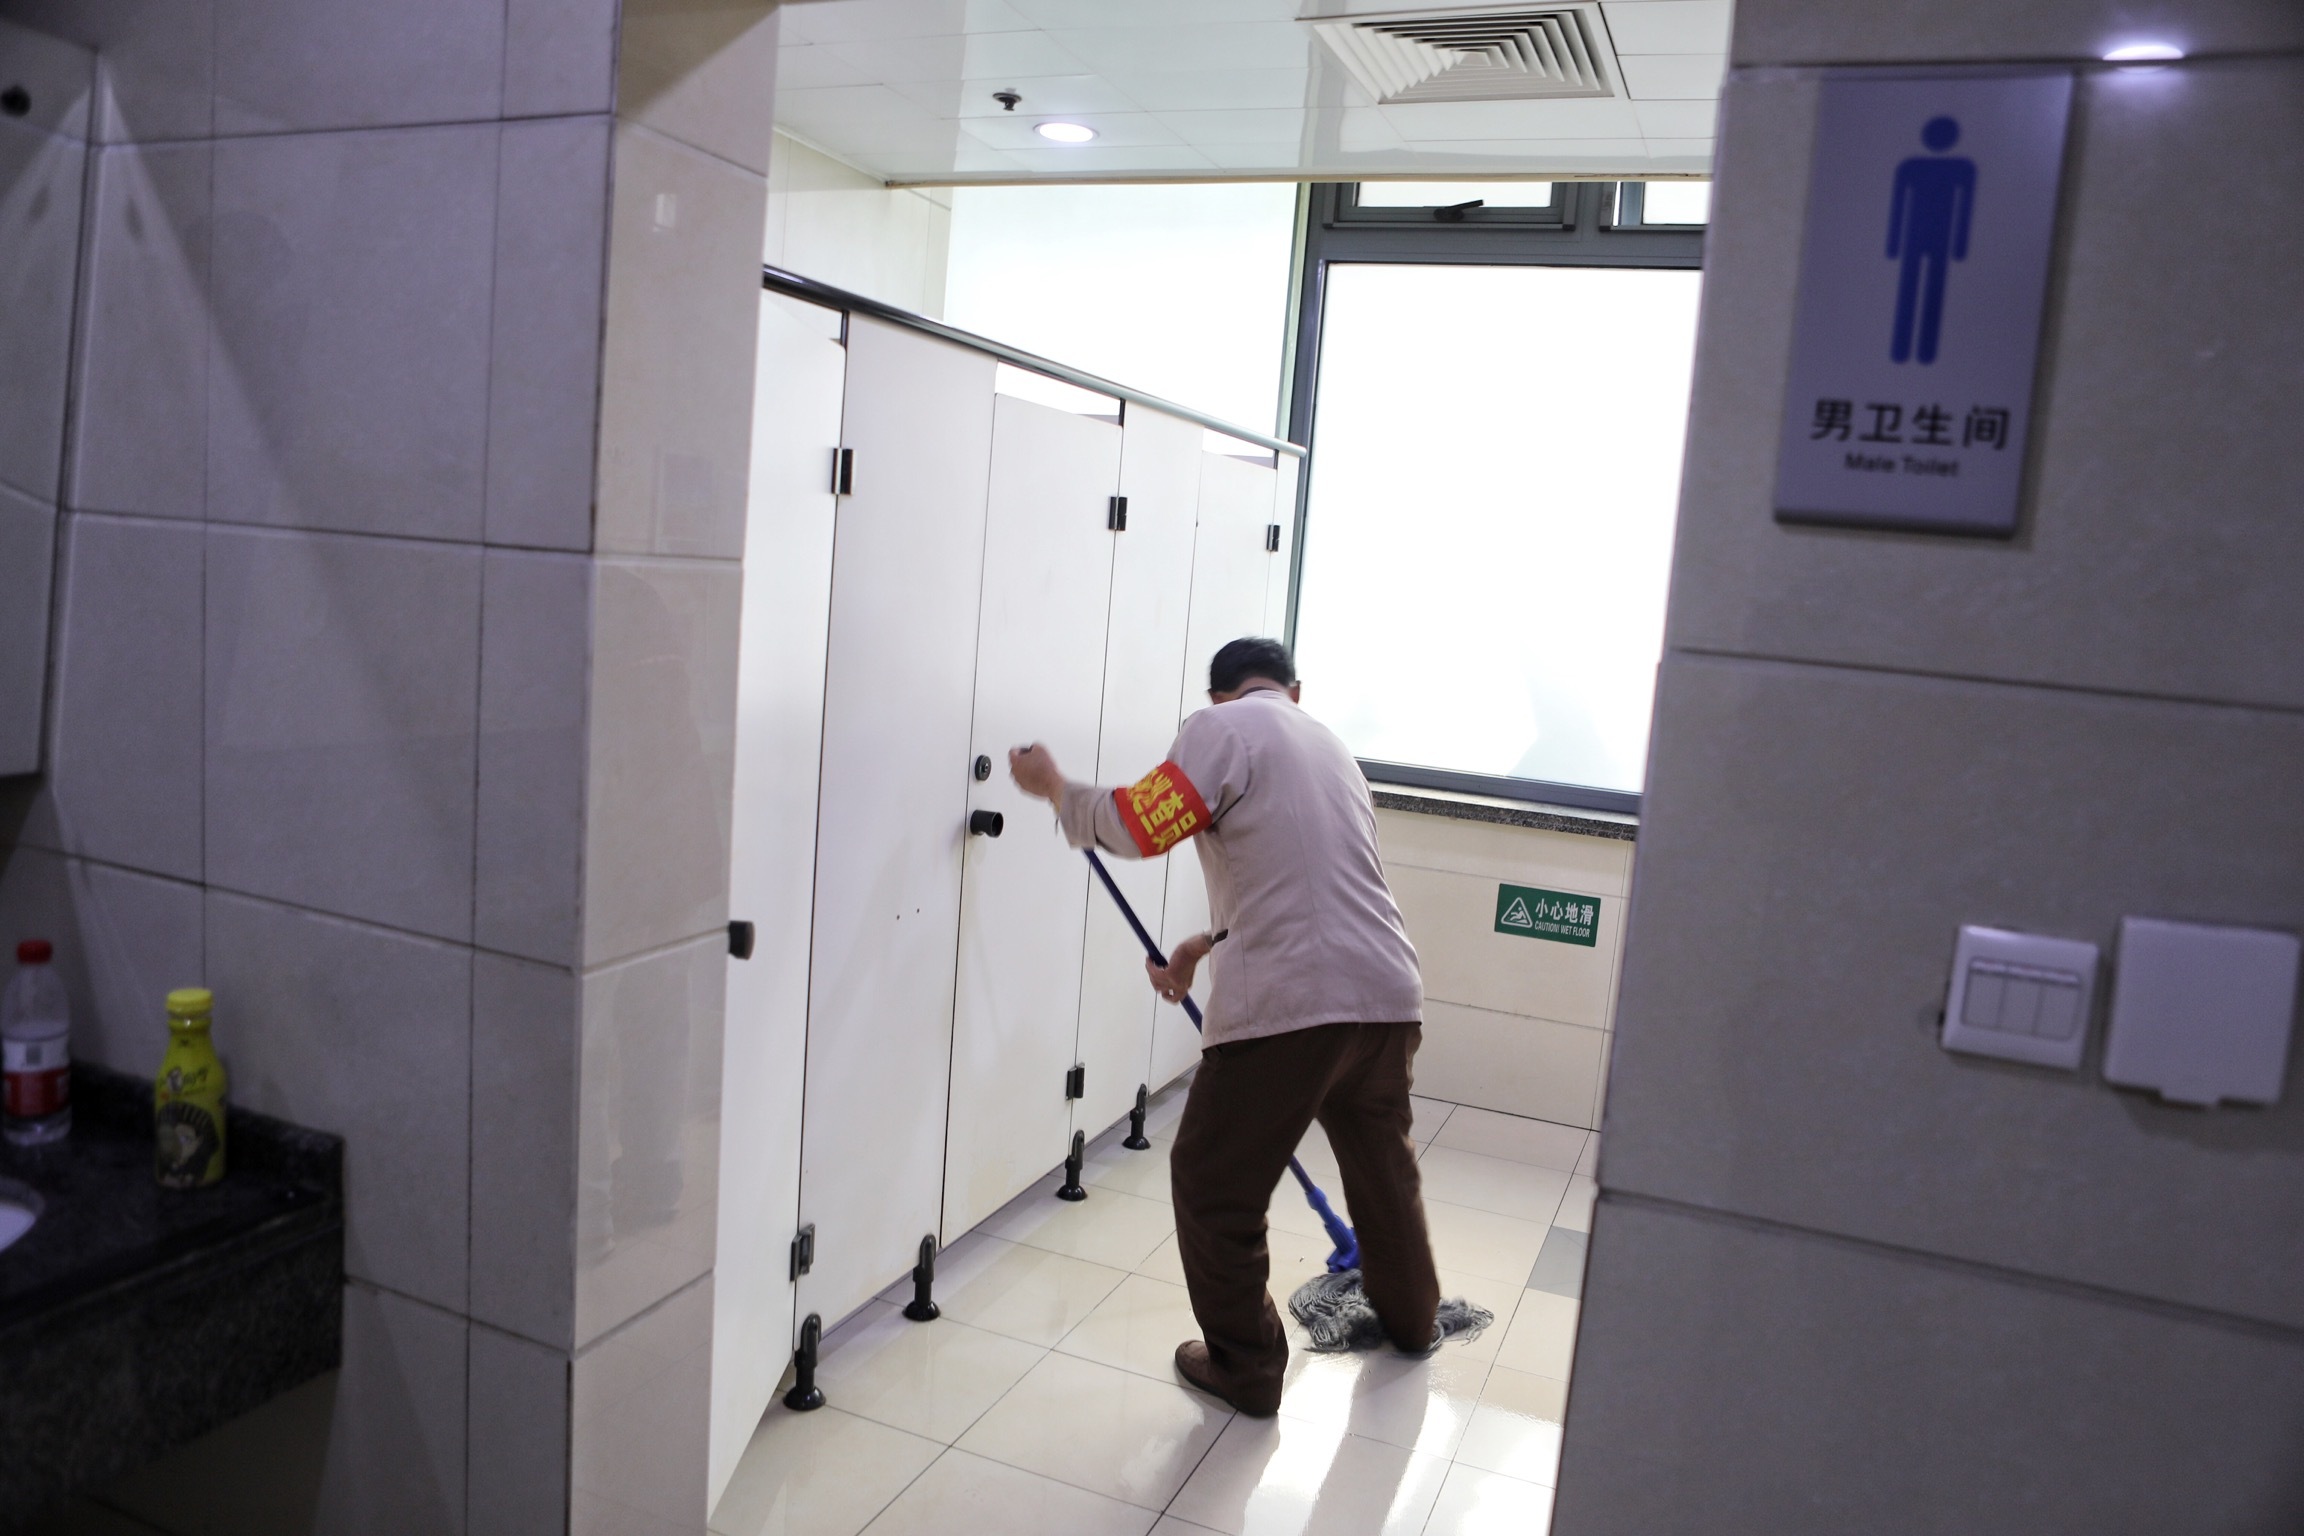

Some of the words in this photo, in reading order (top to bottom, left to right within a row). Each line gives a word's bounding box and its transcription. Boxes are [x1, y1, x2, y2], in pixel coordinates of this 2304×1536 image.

[1811, 398, 2010, 450] 男卫生间
[1845, 453, 1896, 473] Male
[1904, 455, 1959, 477] Toilet
[1535, 898, 1593, 925] 小心地滑
[1534, 921, 1560, 933] CAUTION!
[1560, 925, 1572, 935] WET
[1572, 927, 1590, 938] FLOOR
